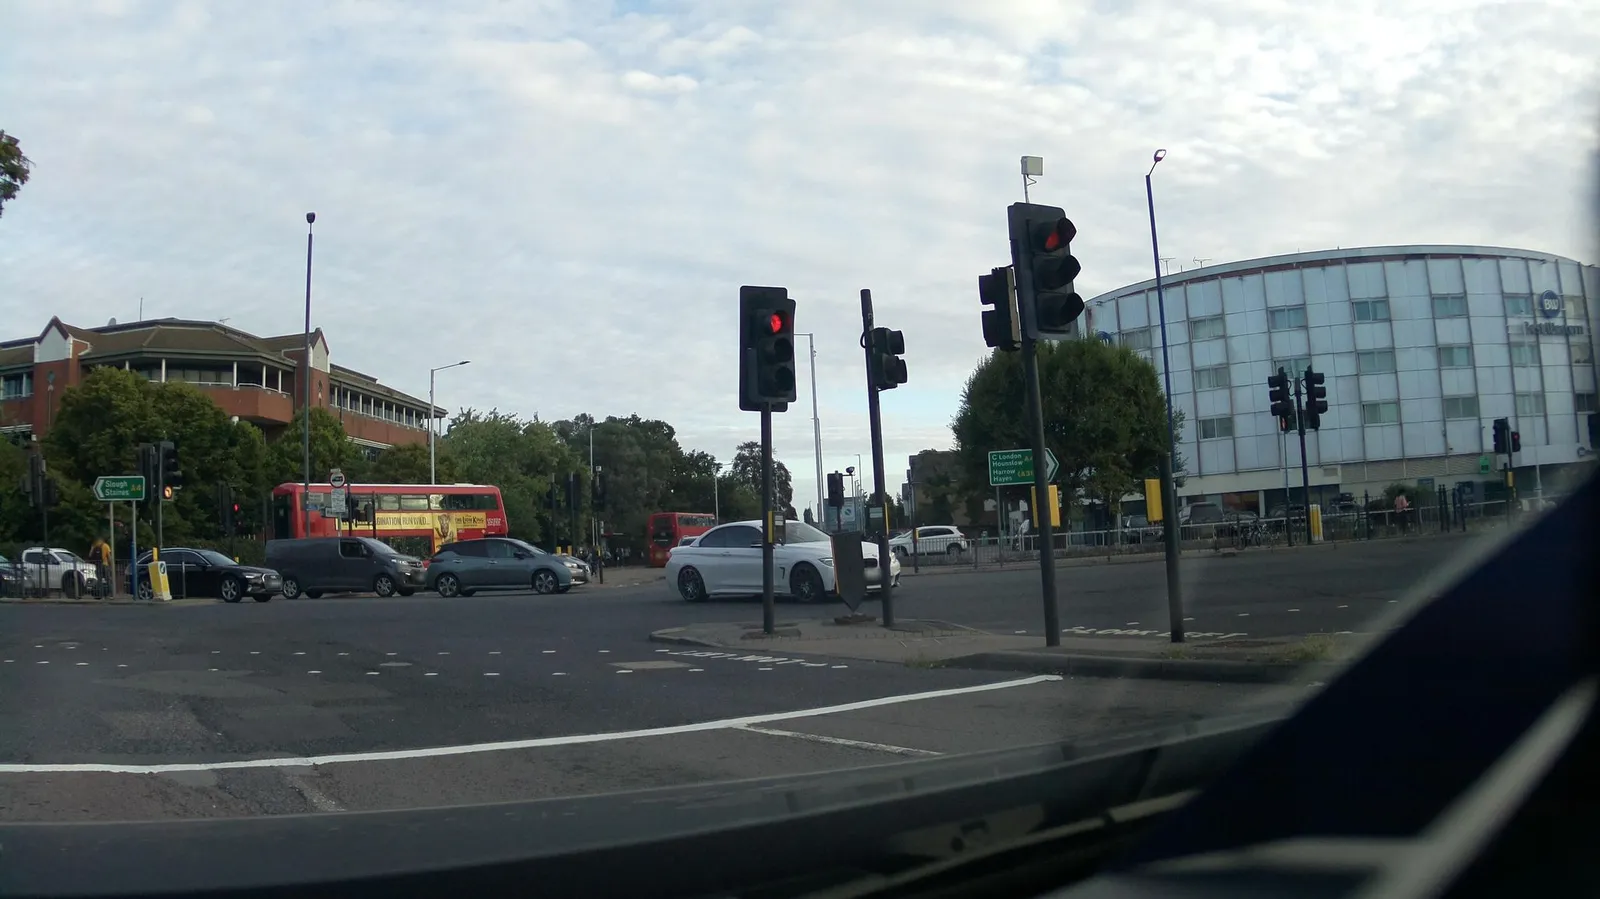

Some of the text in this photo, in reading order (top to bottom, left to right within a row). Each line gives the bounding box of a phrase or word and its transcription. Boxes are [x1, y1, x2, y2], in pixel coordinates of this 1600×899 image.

[1543, 298, 1559, 310] BW
[998, 452, 1022, 460] London
[105, 480, 128, 489] Slough
[105, 488, 130, 496] Staines
